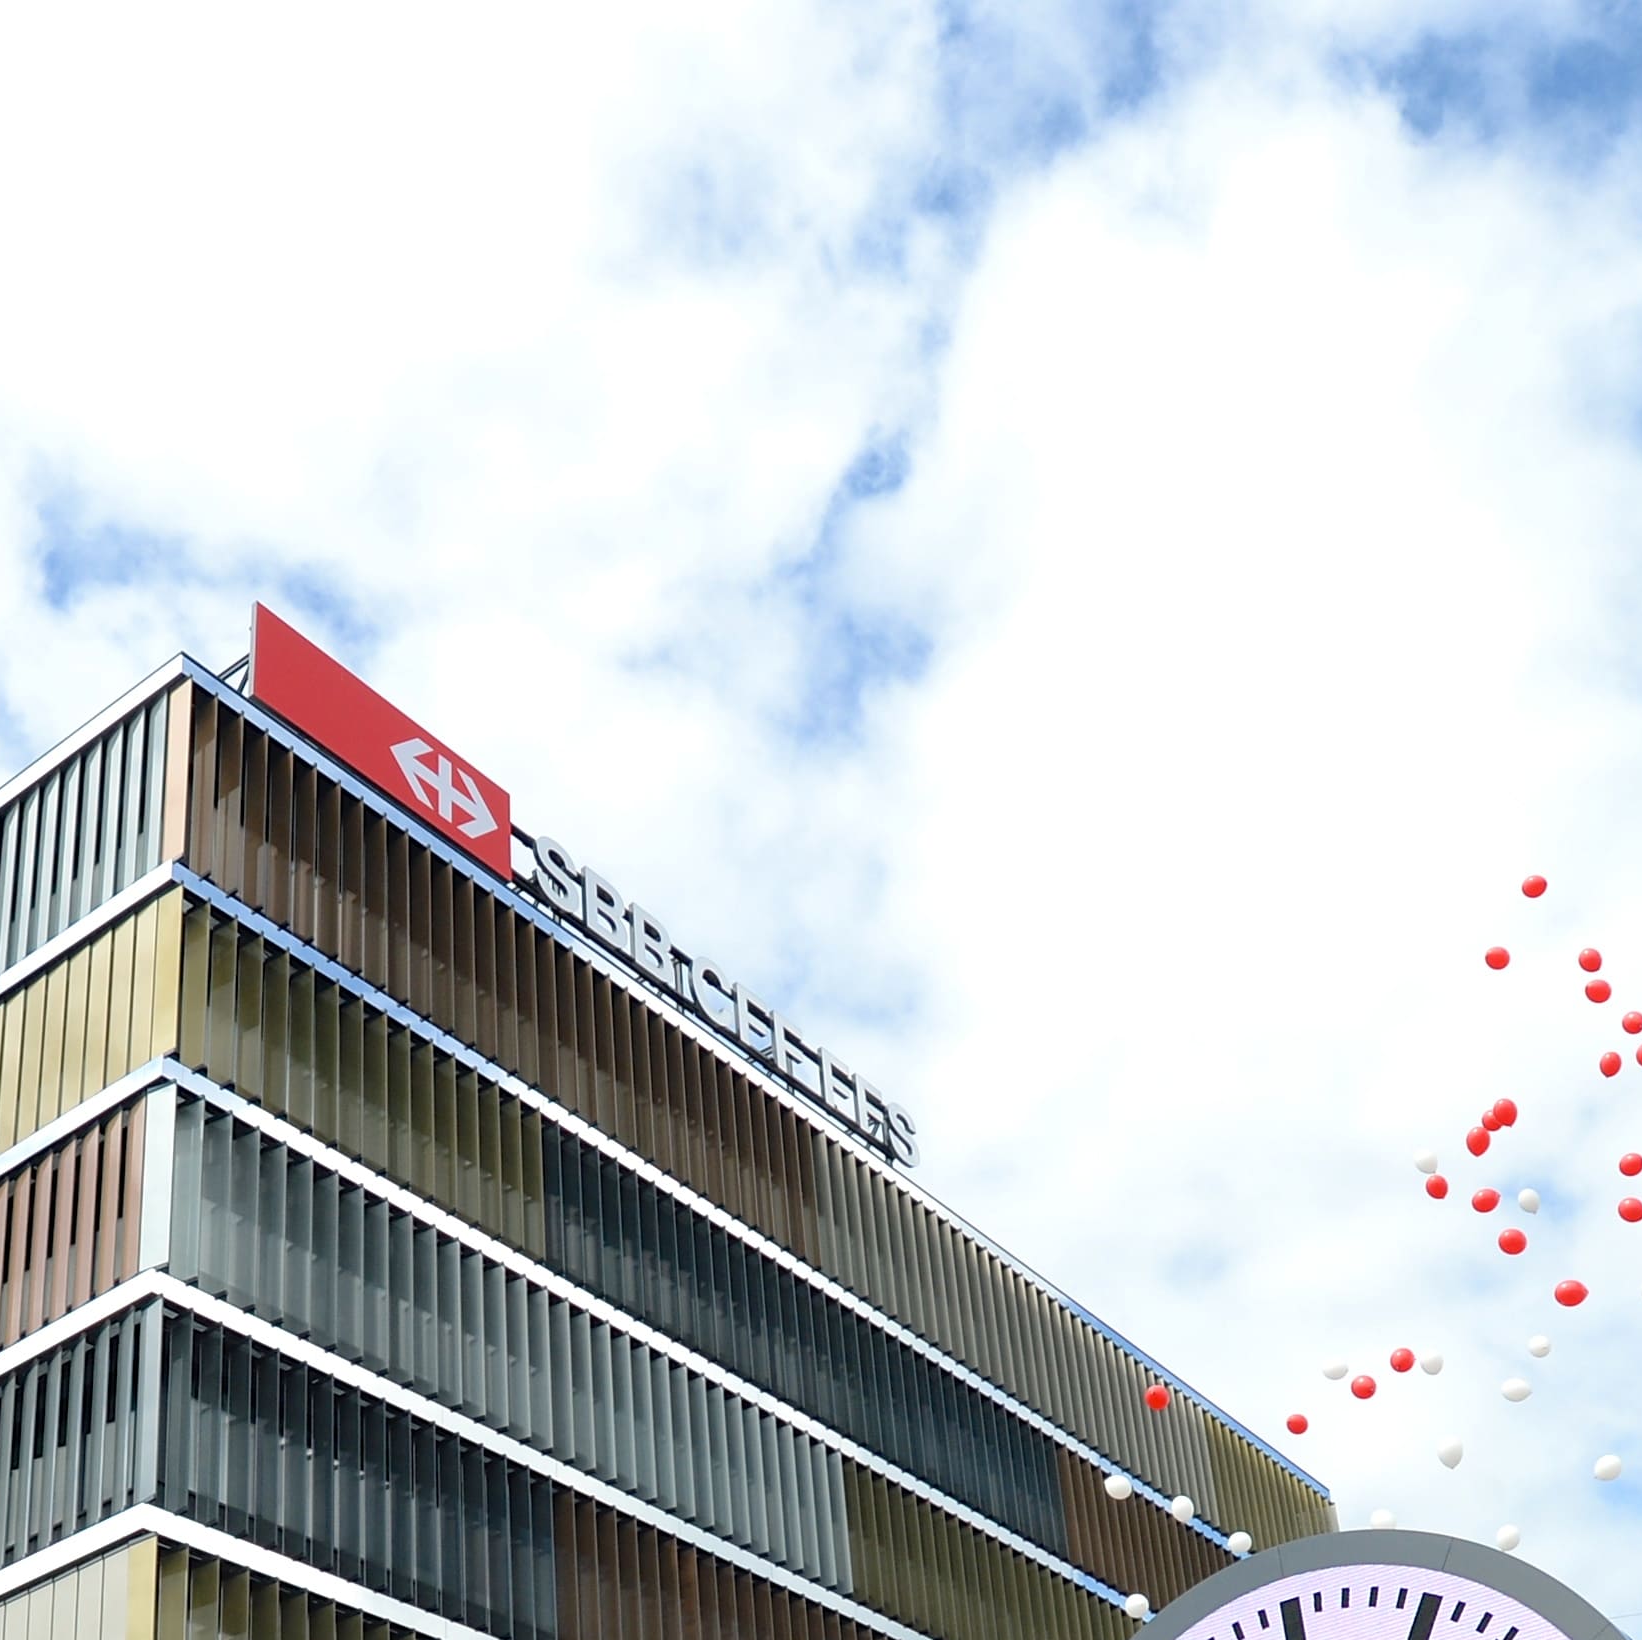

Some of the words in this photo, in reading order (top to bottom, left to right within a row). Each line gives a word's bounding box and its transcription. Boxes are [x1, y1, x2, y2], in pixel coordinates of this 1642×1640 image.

[534, 835, 675, 988] SBB
[691, 956, 803, 1074] CFF
[817, 1046, 921, 1169] FFS
